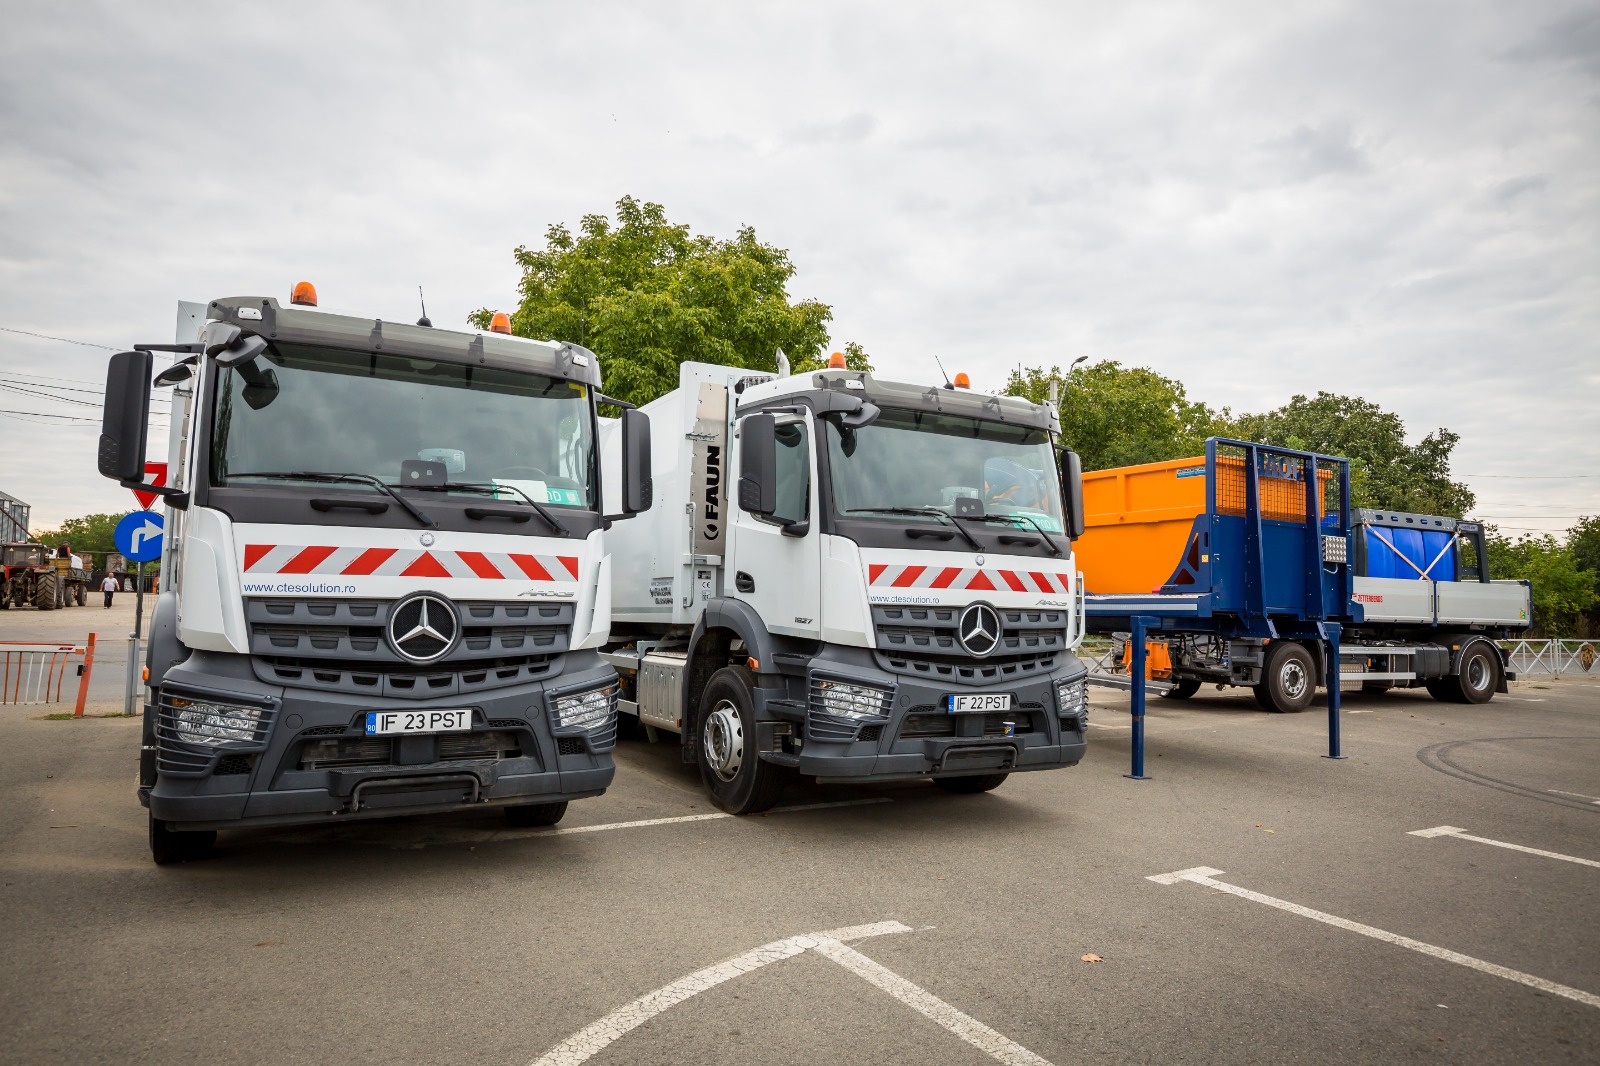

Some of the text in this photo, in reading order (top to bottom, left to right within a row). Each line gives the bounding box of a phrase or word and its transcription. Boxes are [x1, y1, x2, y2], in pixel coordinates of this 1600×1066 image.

[705, 445, 720, 520] FAUN
[243, 582, 356, 593] www.ctesolution.ro
[870, 595, 940, 604] www.ctesolution.ro
[956, 696, 967, 710] IF
[970, 696, 984, 710] 22
[985, 696, 1008, 709] PST
[381, 711, 466, 731] IF 23 PST
[367, 724, 376, 732] RO
